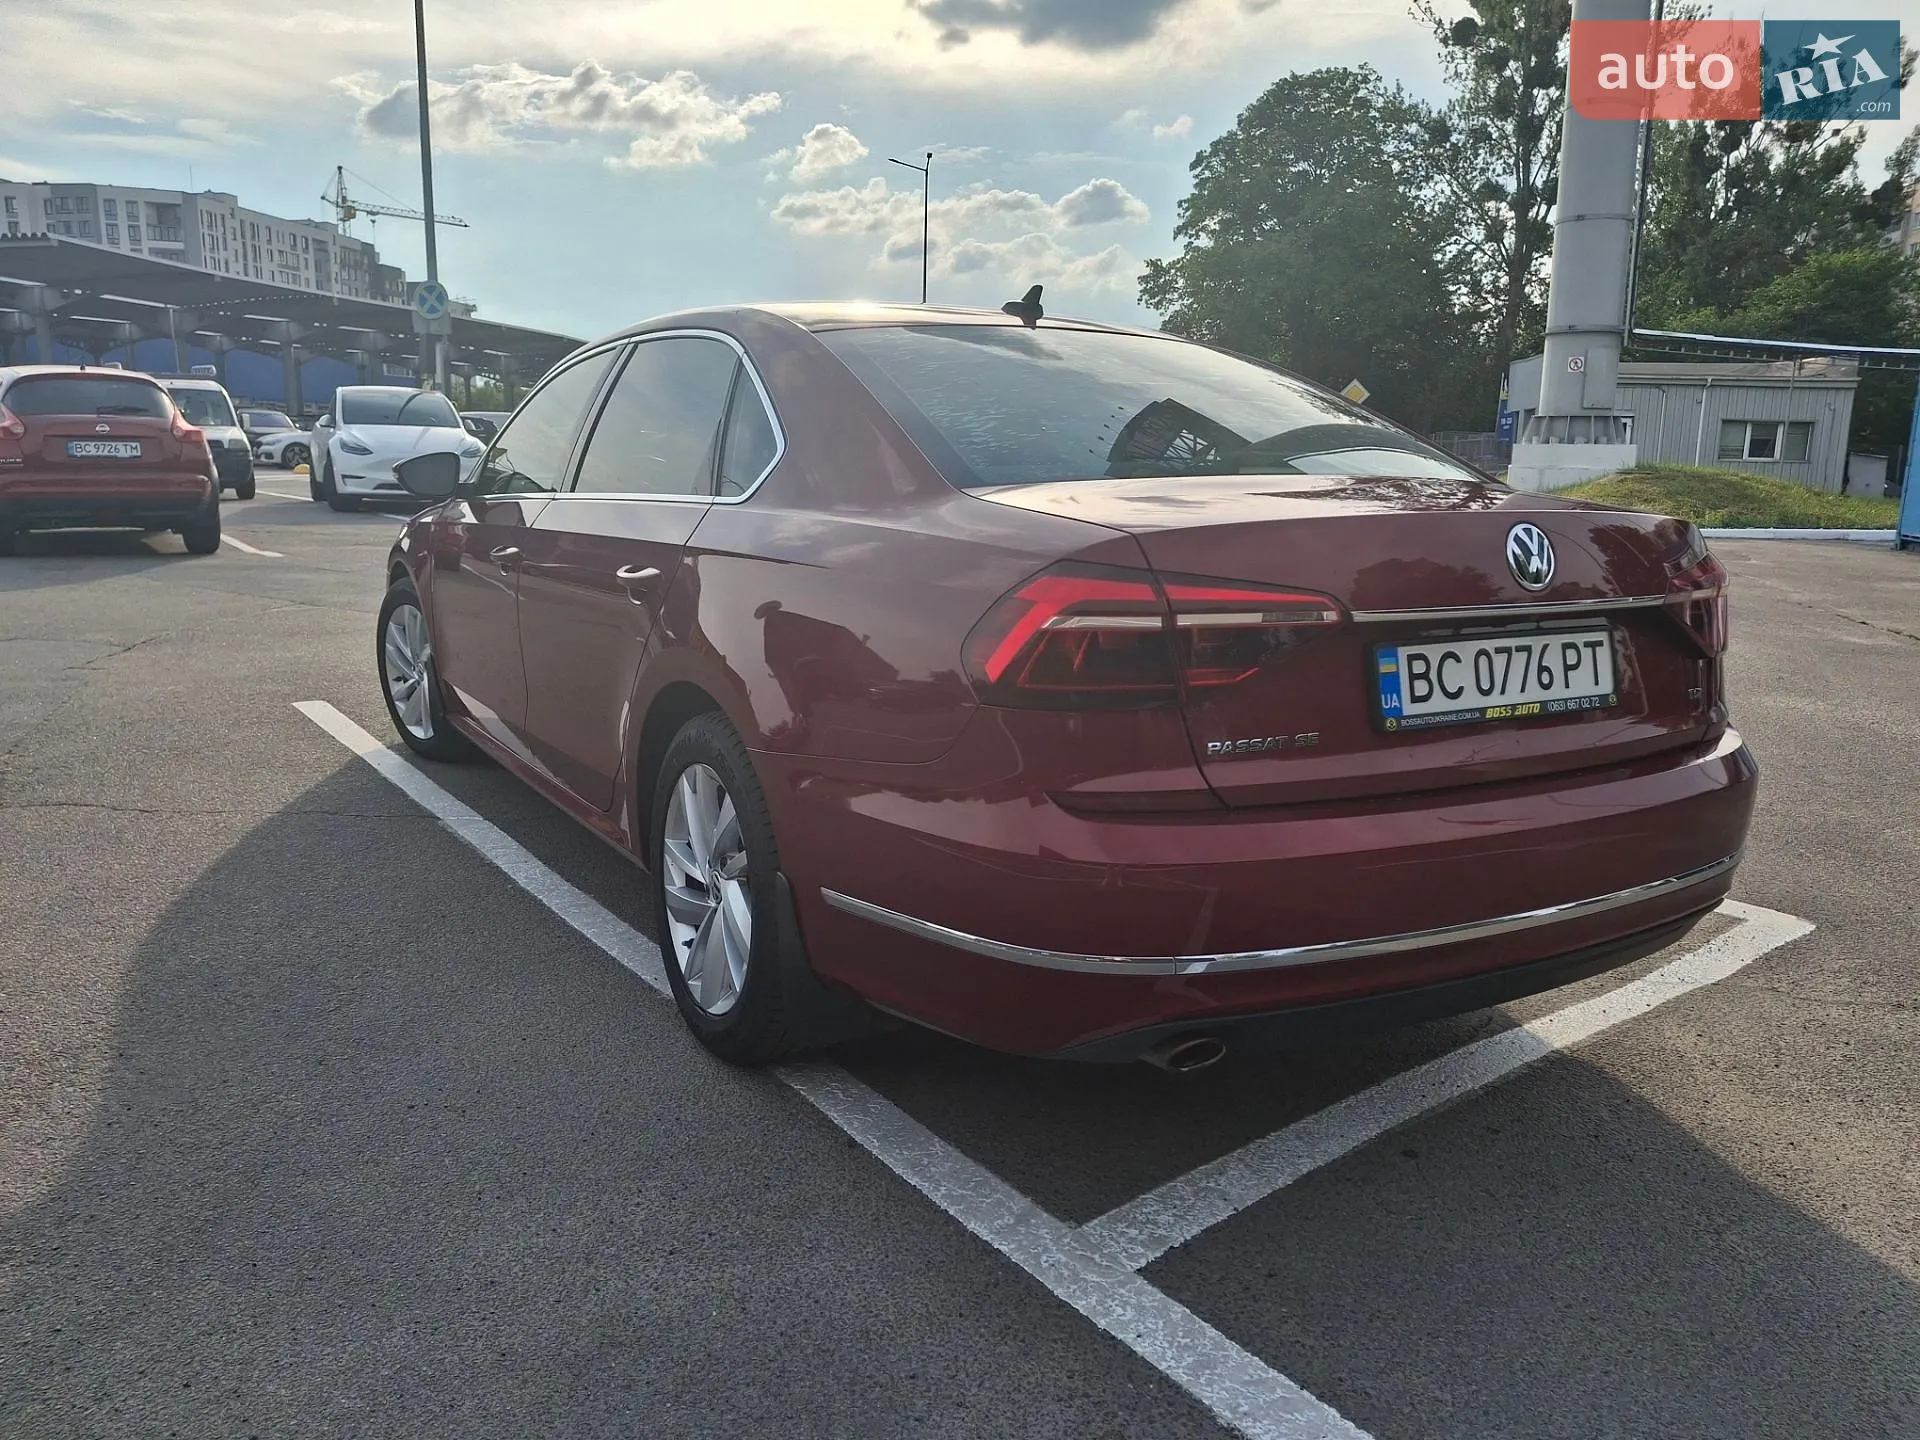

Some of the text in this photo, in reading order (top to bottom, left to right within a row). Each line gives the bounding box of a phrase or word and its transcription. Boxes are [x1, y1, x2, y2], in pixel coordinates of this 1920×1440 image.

[74, 443, 139, 453] BC 9726 TM
[1406, 640, 1604, 703] BC 0776 PT
[1382, 693, 1401, 709] UA
[1486, 706, 1513, 719] BOSS
[1207, 732, 1319, 754] PASSAT SE
